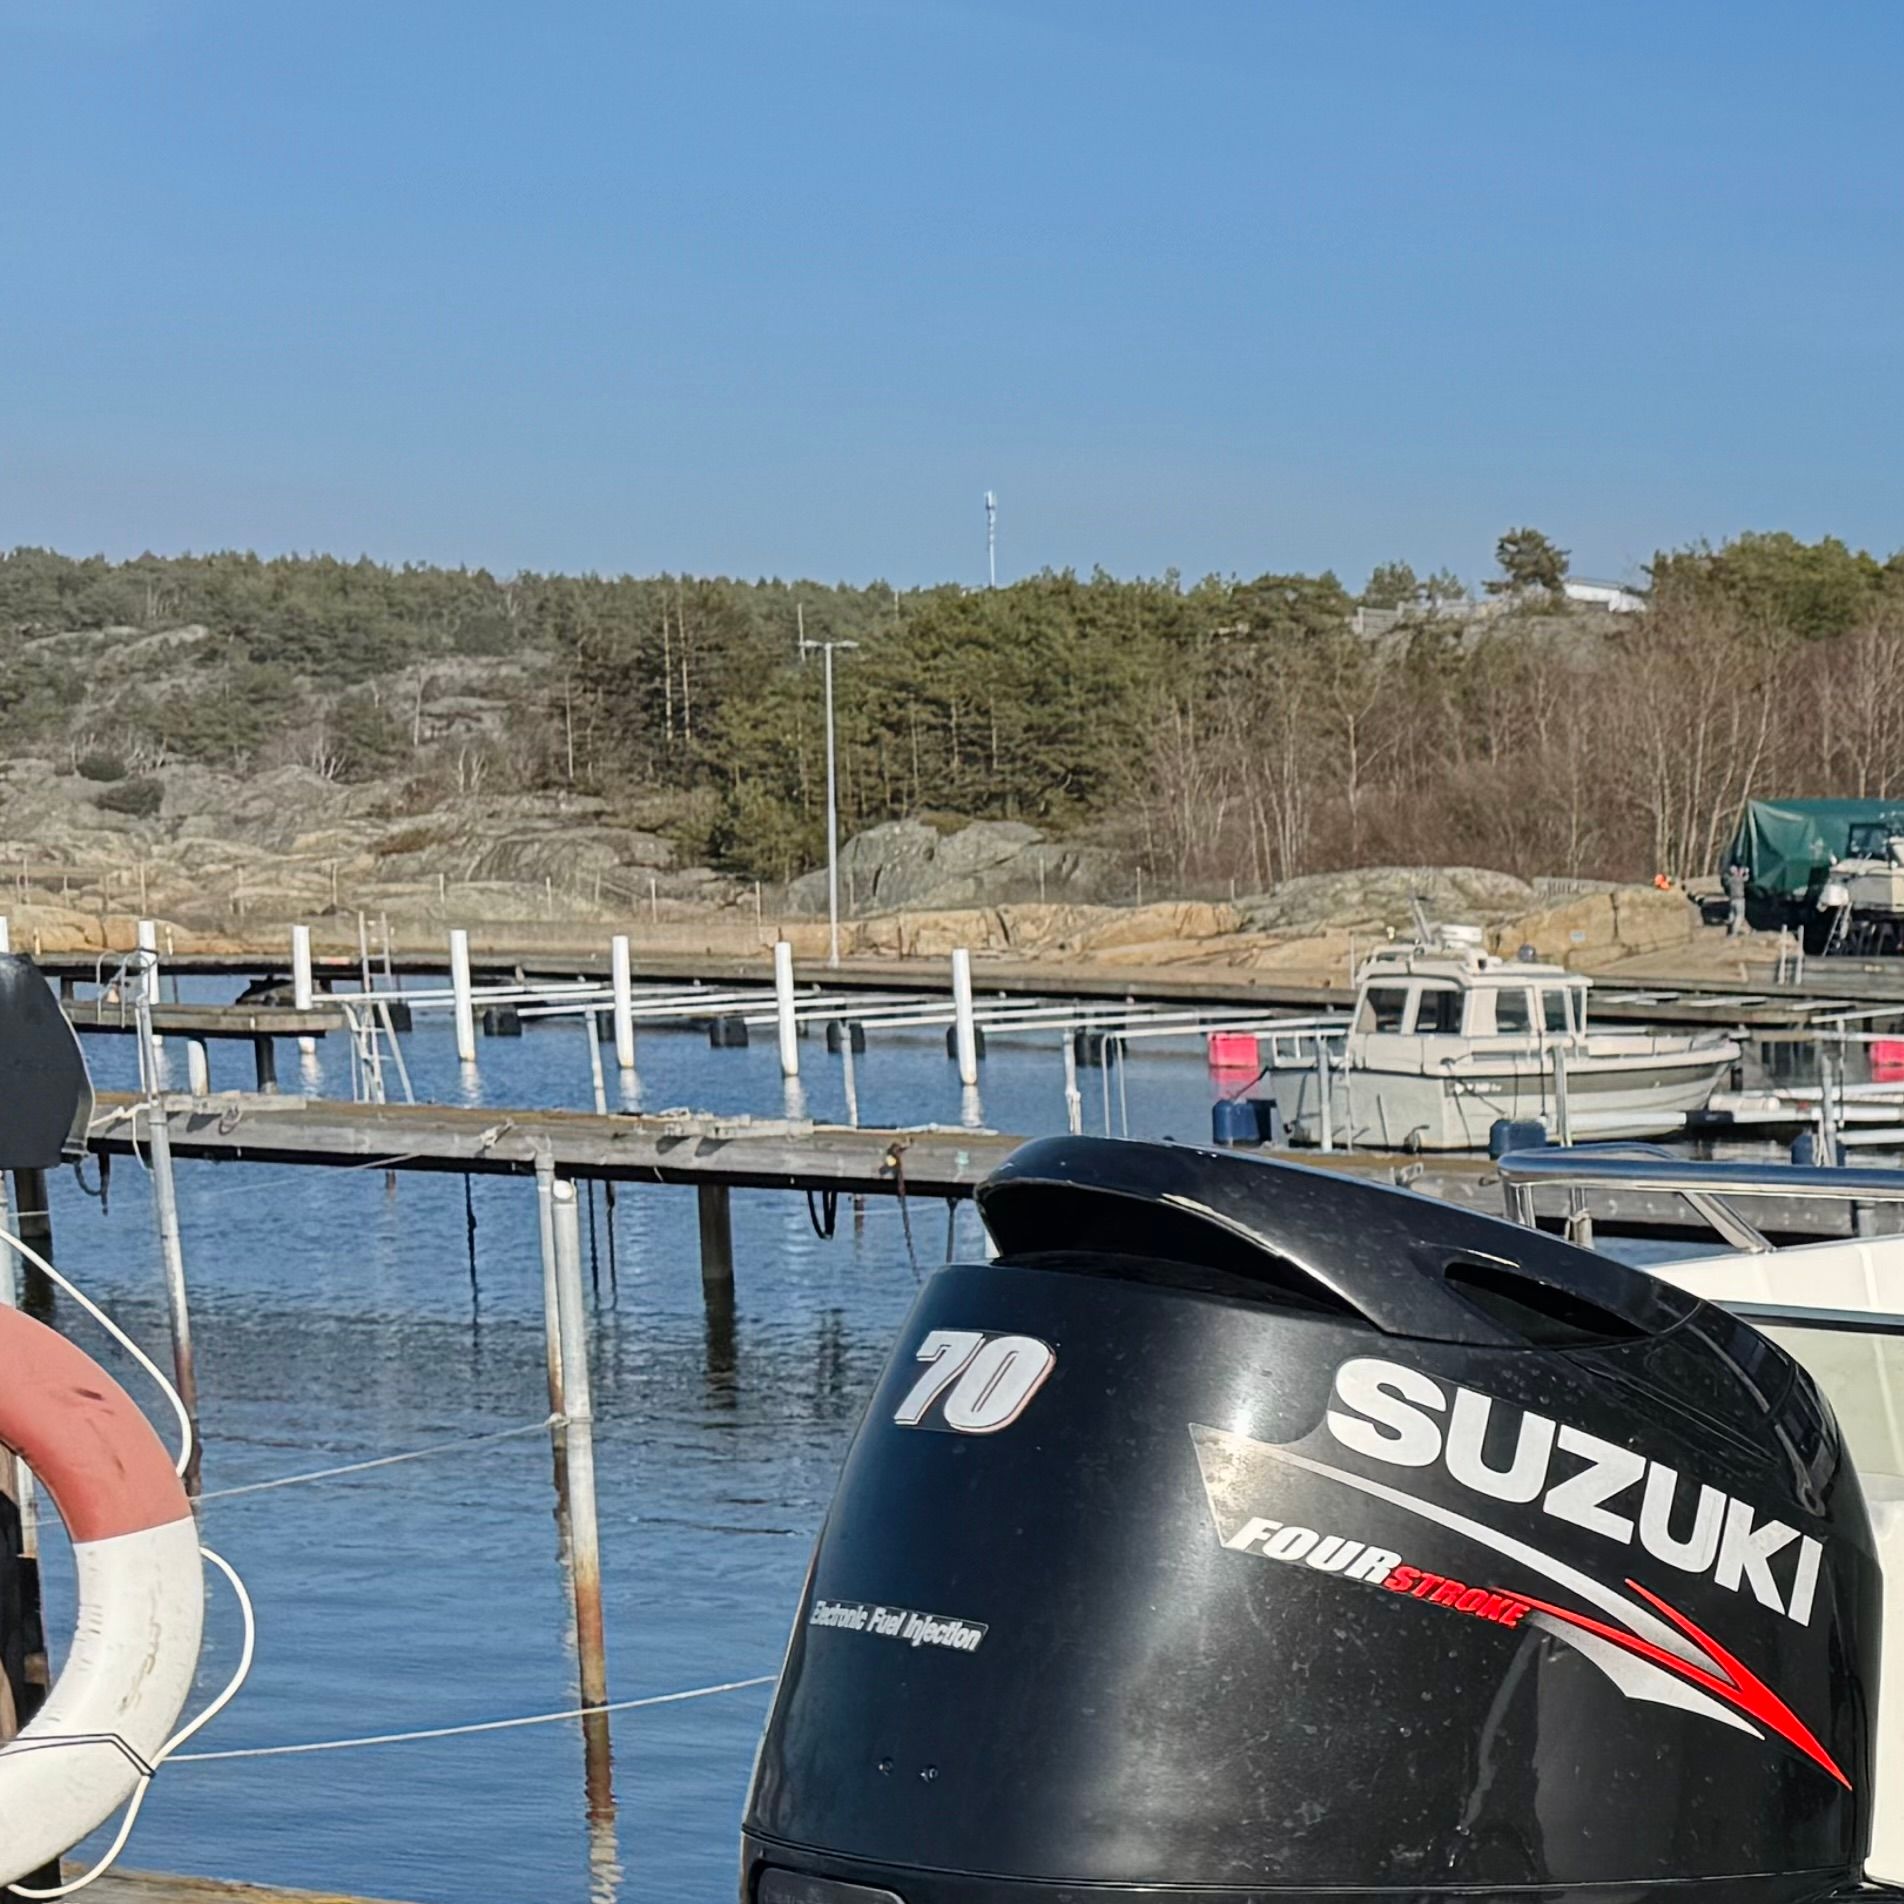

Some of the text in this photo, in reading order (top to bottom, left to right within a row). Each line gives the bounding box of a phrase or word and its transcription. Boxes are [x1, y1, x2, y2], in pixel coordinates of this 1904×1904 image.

[893, 1330, 1057, 1433] 70
[1326, 1355, 1823, 1627] SUZUKI
[809, 1600, 983, 1652] Electronic Fuel Injection
